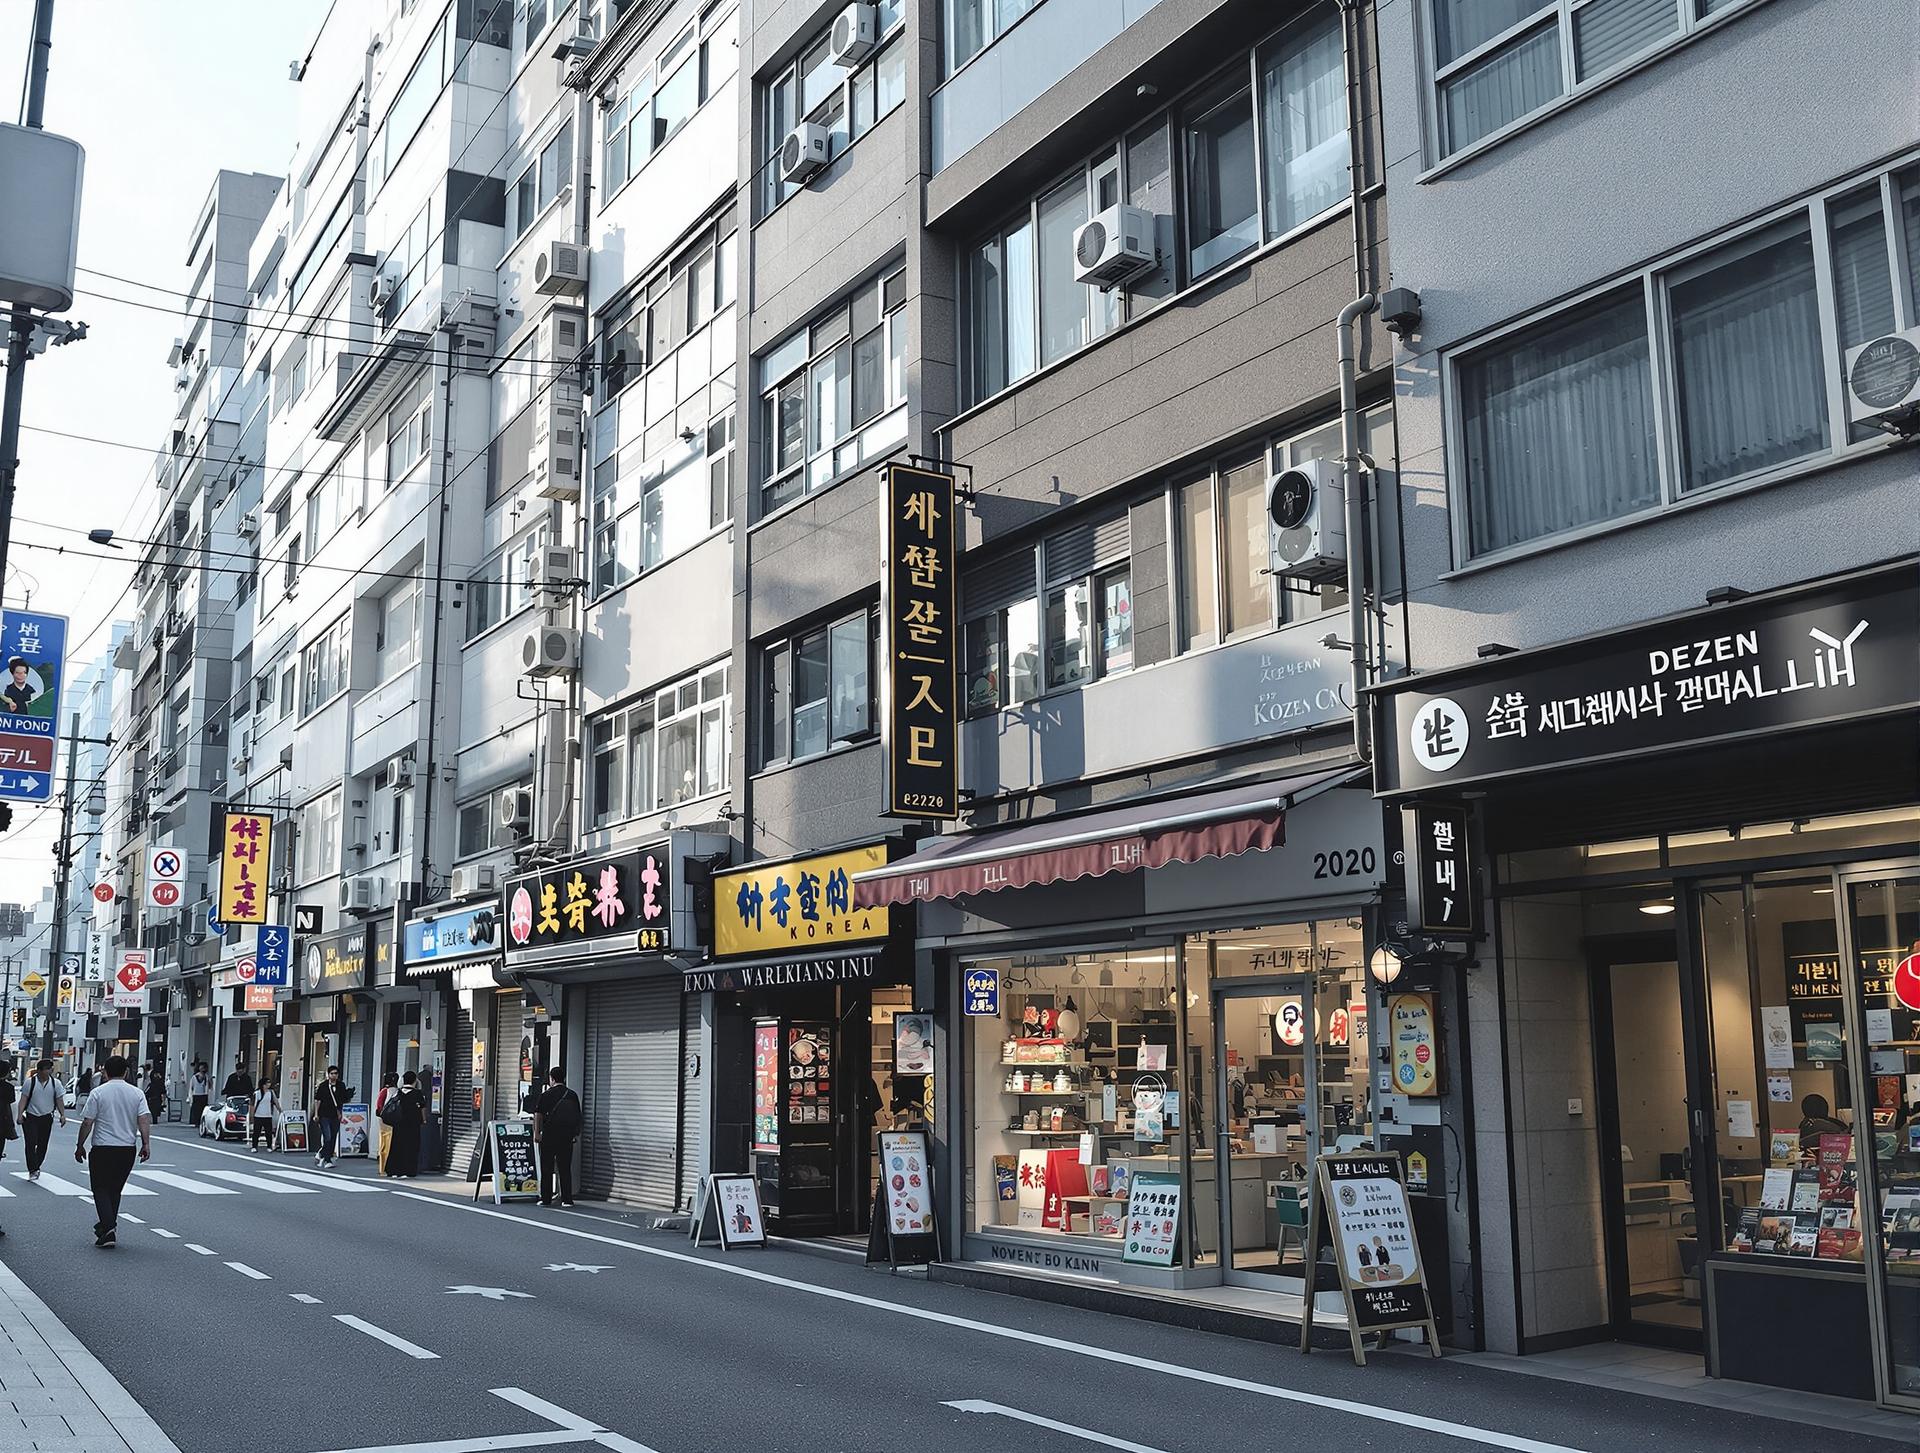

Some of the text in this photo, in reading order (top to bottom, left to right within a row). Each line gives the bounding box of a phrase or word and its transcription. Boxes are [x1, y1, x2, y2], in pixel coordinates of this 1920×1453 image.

[1649, 630, 1759, 676] DEZEN
[15, 720, 51, 732] POND
[1313, 846, 1377, 879] 2020
[296, 911, 314, 930] N
[790, 917, 871, 940] KOREA
